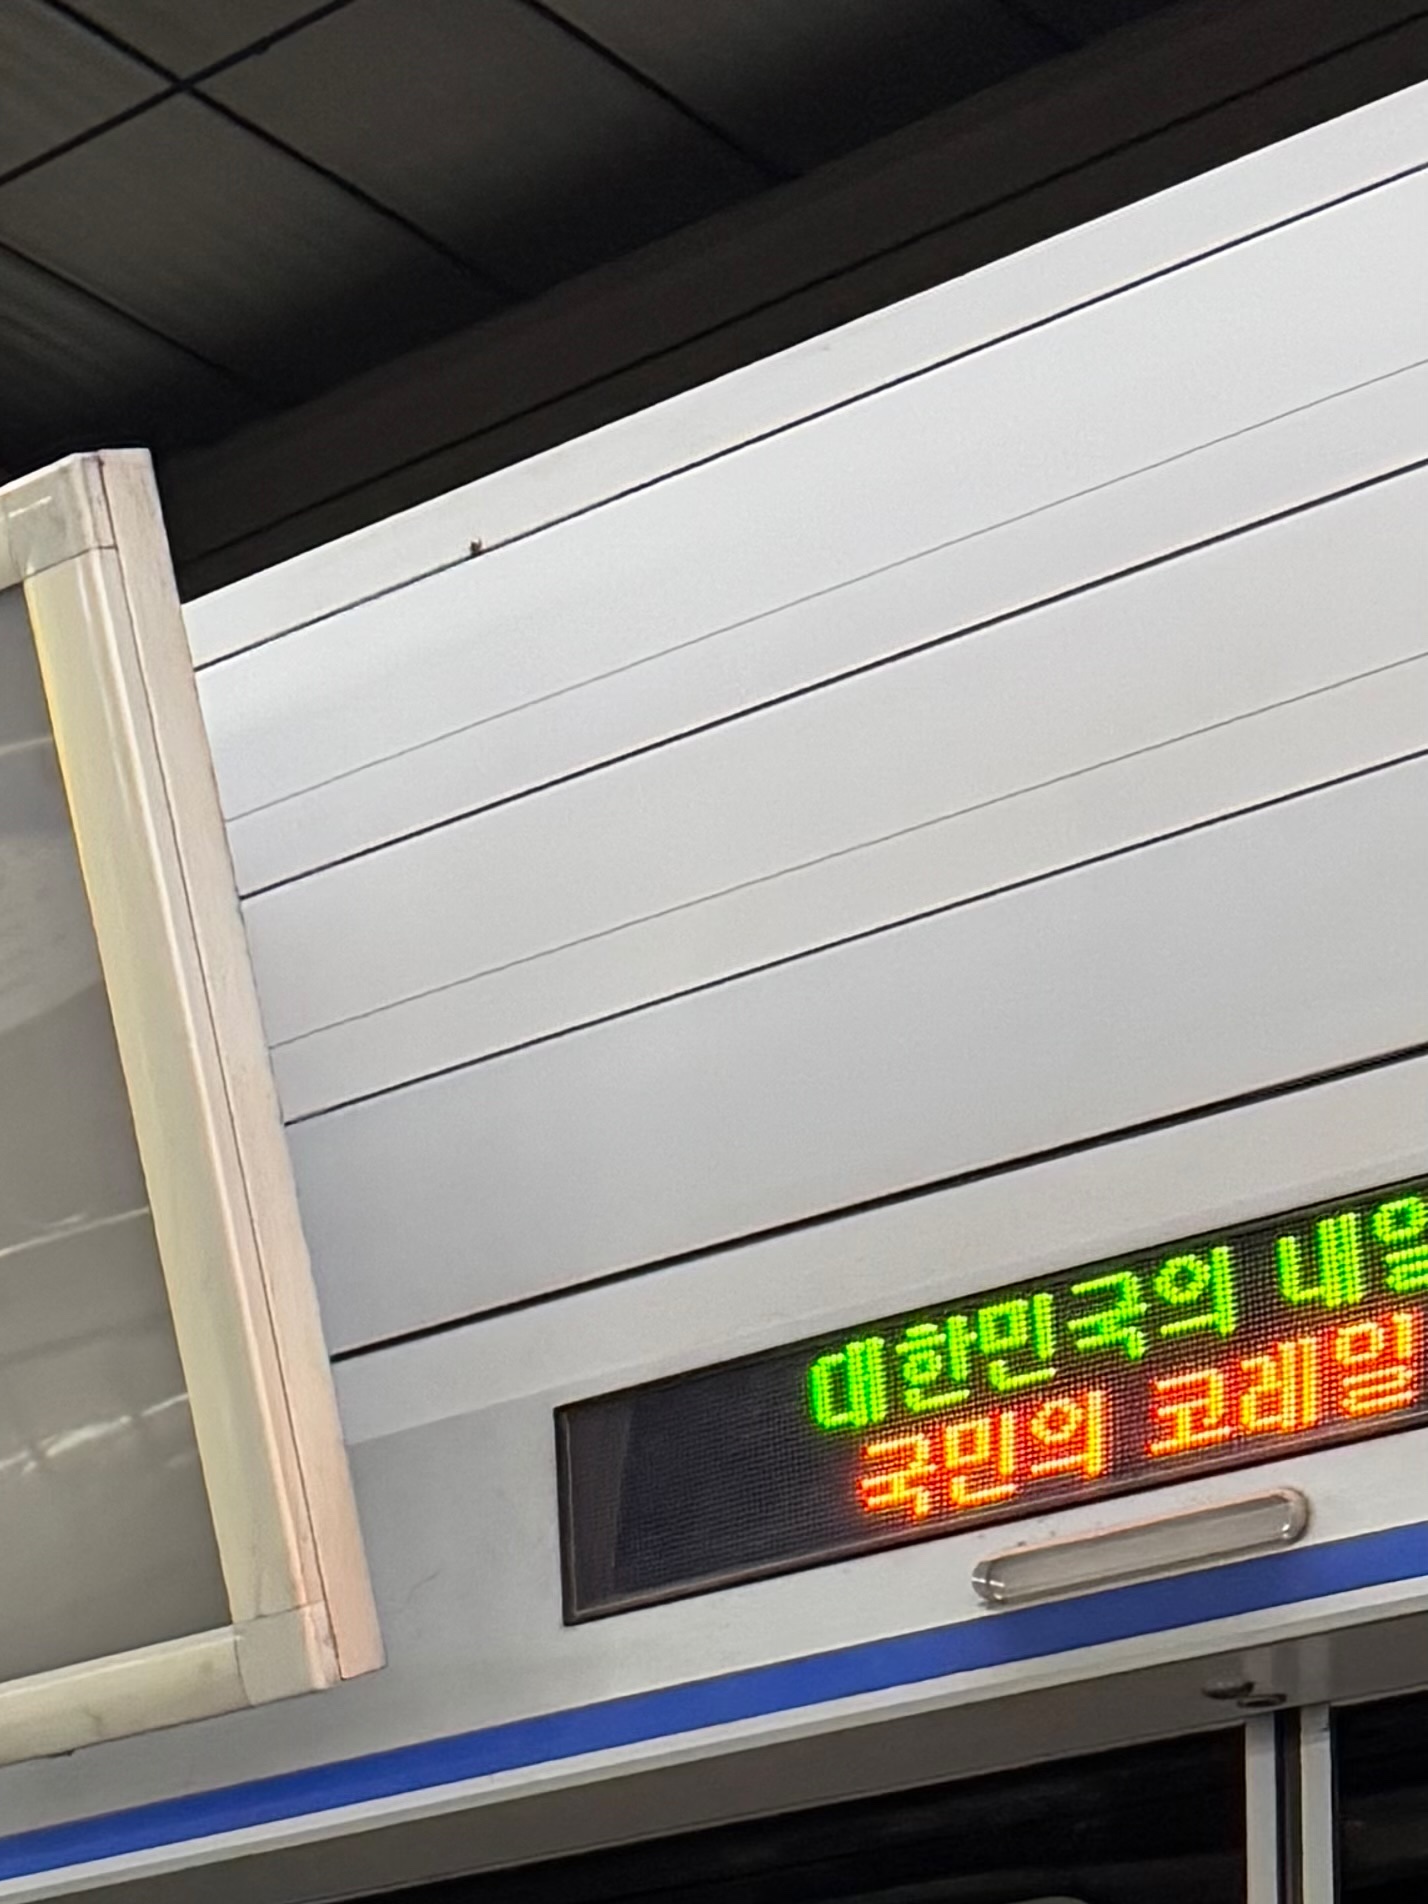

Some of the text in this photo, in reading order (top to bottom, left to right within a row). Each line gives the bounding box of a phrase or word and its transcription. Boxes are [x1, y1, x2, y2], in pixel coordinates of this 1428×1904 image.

[807, 1247, 1236, 1431] 대한민국의
[856, 1308, 1415, 1522] 국민의 코레일
